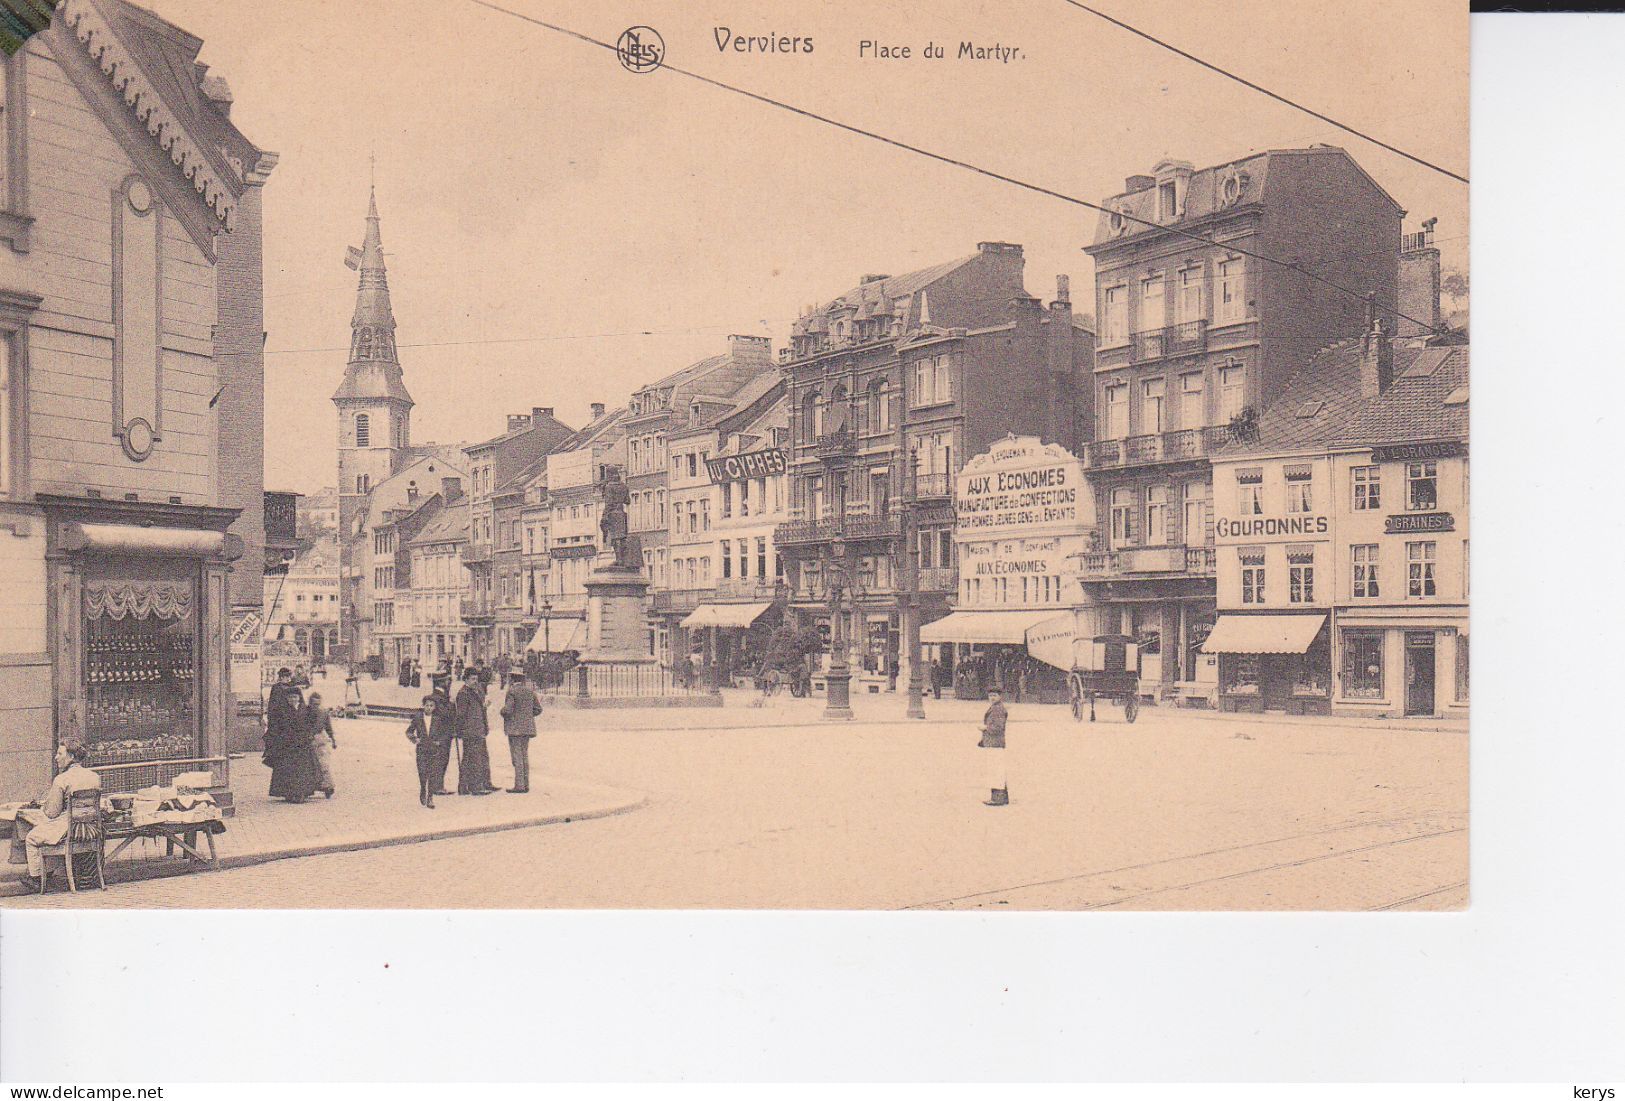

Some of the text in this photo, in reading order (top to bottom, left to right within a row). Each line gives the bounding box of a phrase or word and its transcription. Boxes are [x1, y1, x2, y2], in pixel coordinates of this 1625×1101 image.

[967, 476, 991, 496] AUX
[959, 495, 1009, 513] MANUFACTURE
[1019, 488, 1076, 508] CONFECTIONS
[958, 516, 971, 529] POUR
[1044, 507, 1076, 522] ENFANTS
[1216, 516, 1328, 538] COURONNES
[1395, 515, 1442, 529] GRAINES
[1004, 545, 1013, 554] DE
[976, 562, 994, 575] AUX
